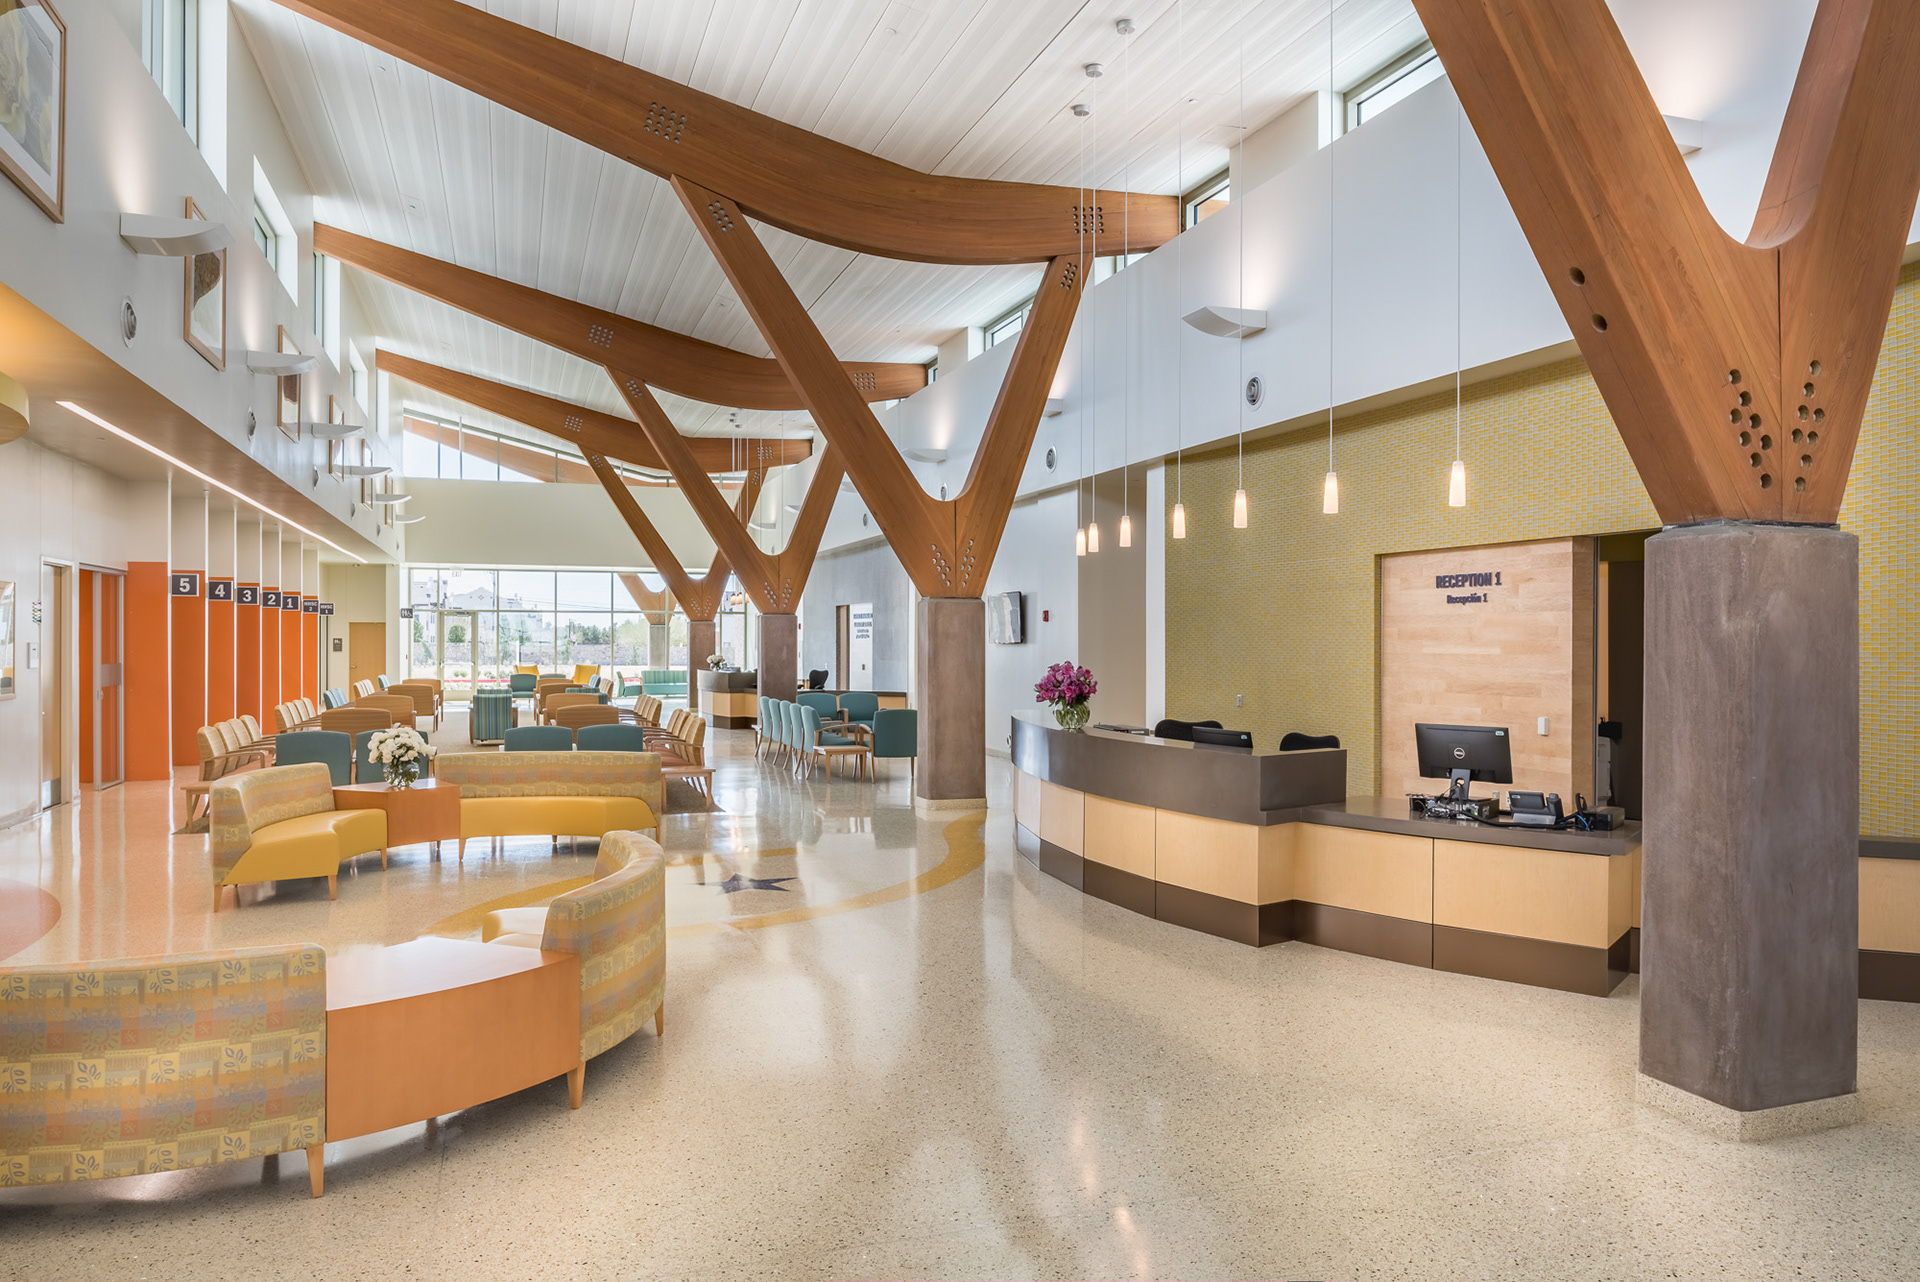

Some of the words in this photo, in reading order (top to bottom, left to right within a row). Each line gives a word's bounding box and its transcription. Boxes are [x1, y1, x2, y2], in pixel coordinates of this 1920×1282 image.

[179, 577, 191, 592] 5
[1436, 572, 1492, 588] RECEPTION
[1495, 572, 1502, 586] 1
[214, 584, 225, 597] 4
[242, 589, 252, 602] 3
[267, 594, 276, 605] 2
[286, 598, 294, 609] 1
[1483, 593, 1488, 602] 1
